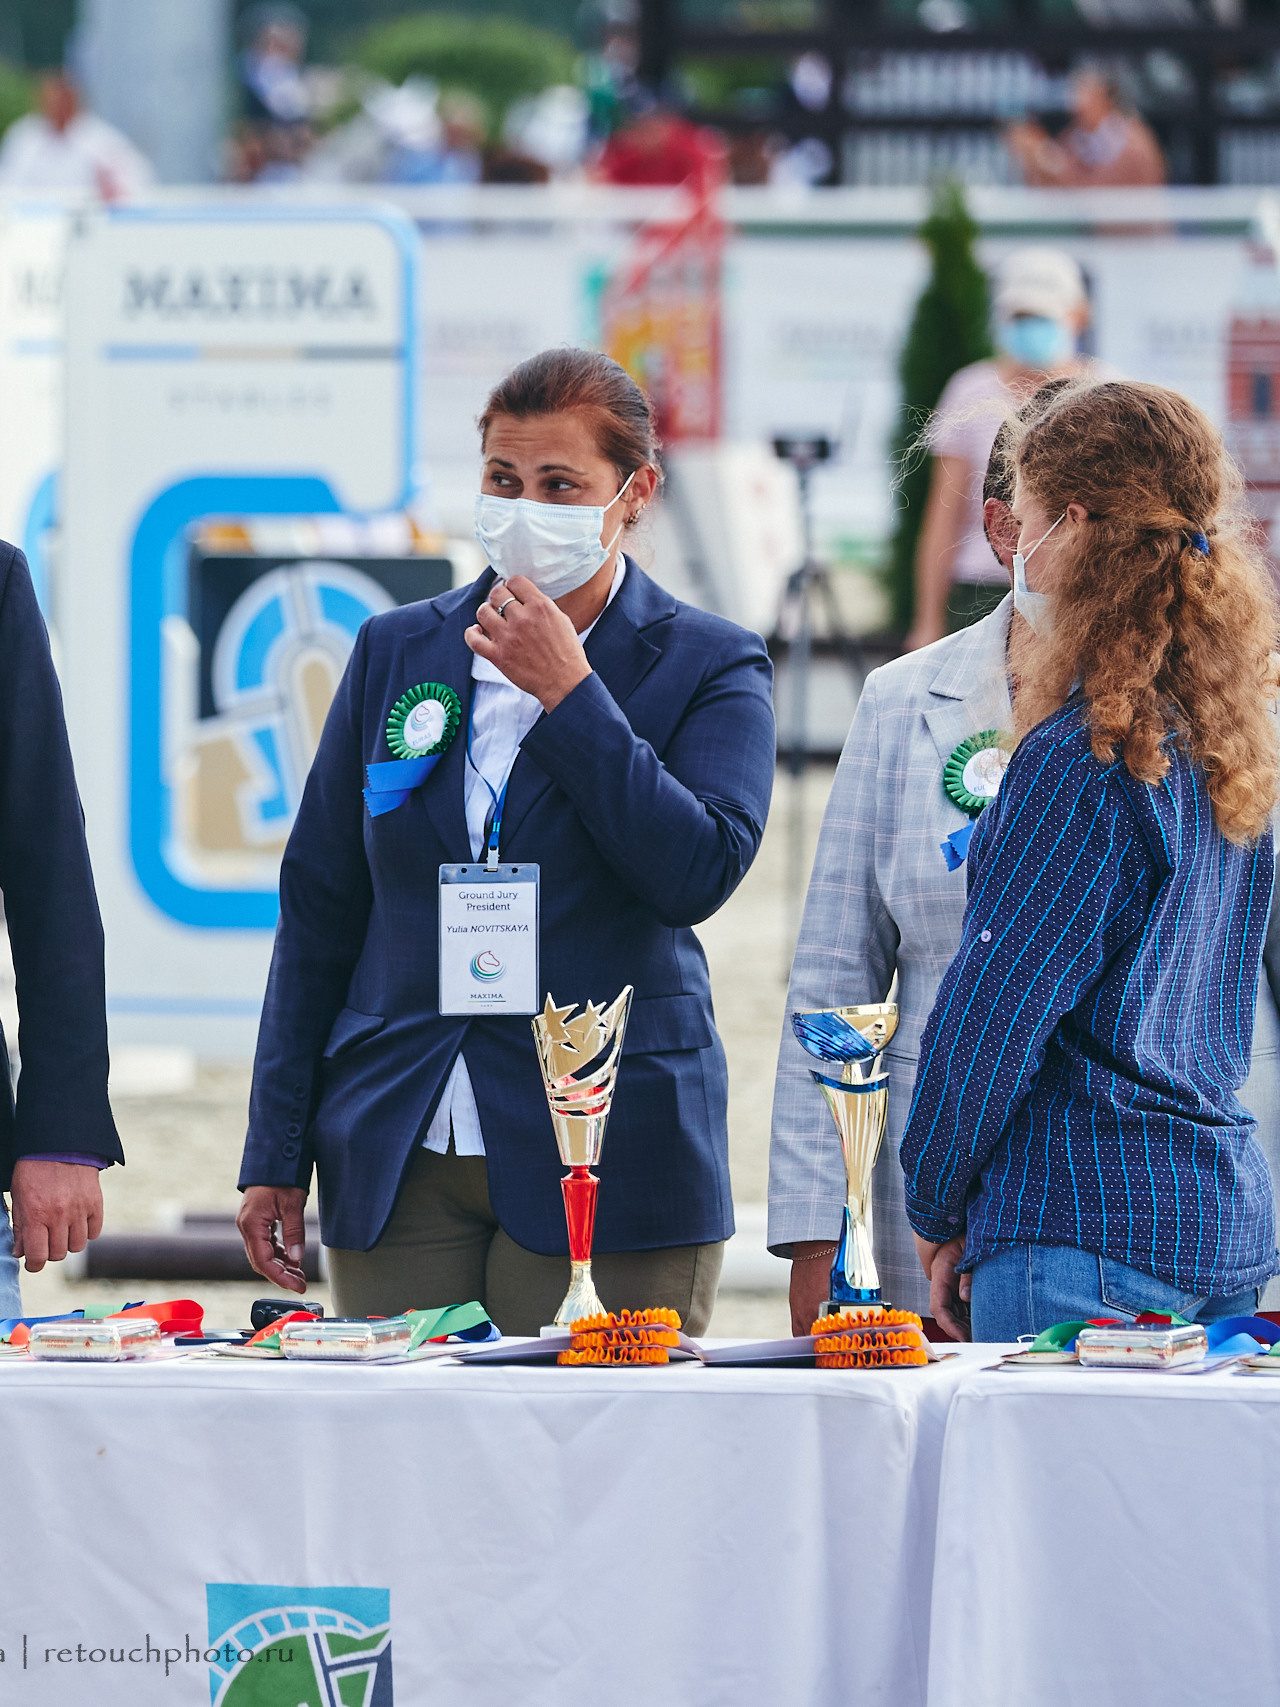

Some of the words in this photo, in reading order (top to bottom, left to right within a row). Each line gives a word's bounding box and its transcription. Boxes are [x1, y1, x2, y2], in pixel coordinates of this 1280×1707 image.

[122, 264, 380, 323] MAXIMA
[458, 891, 495, 900] Ground
[497, 891, 519, 901] Jury
[466, 902, 511, 911] President
[446, 925, 468, 933] Yulia
[470, 924, 530, 933] NOVITSKAYA
